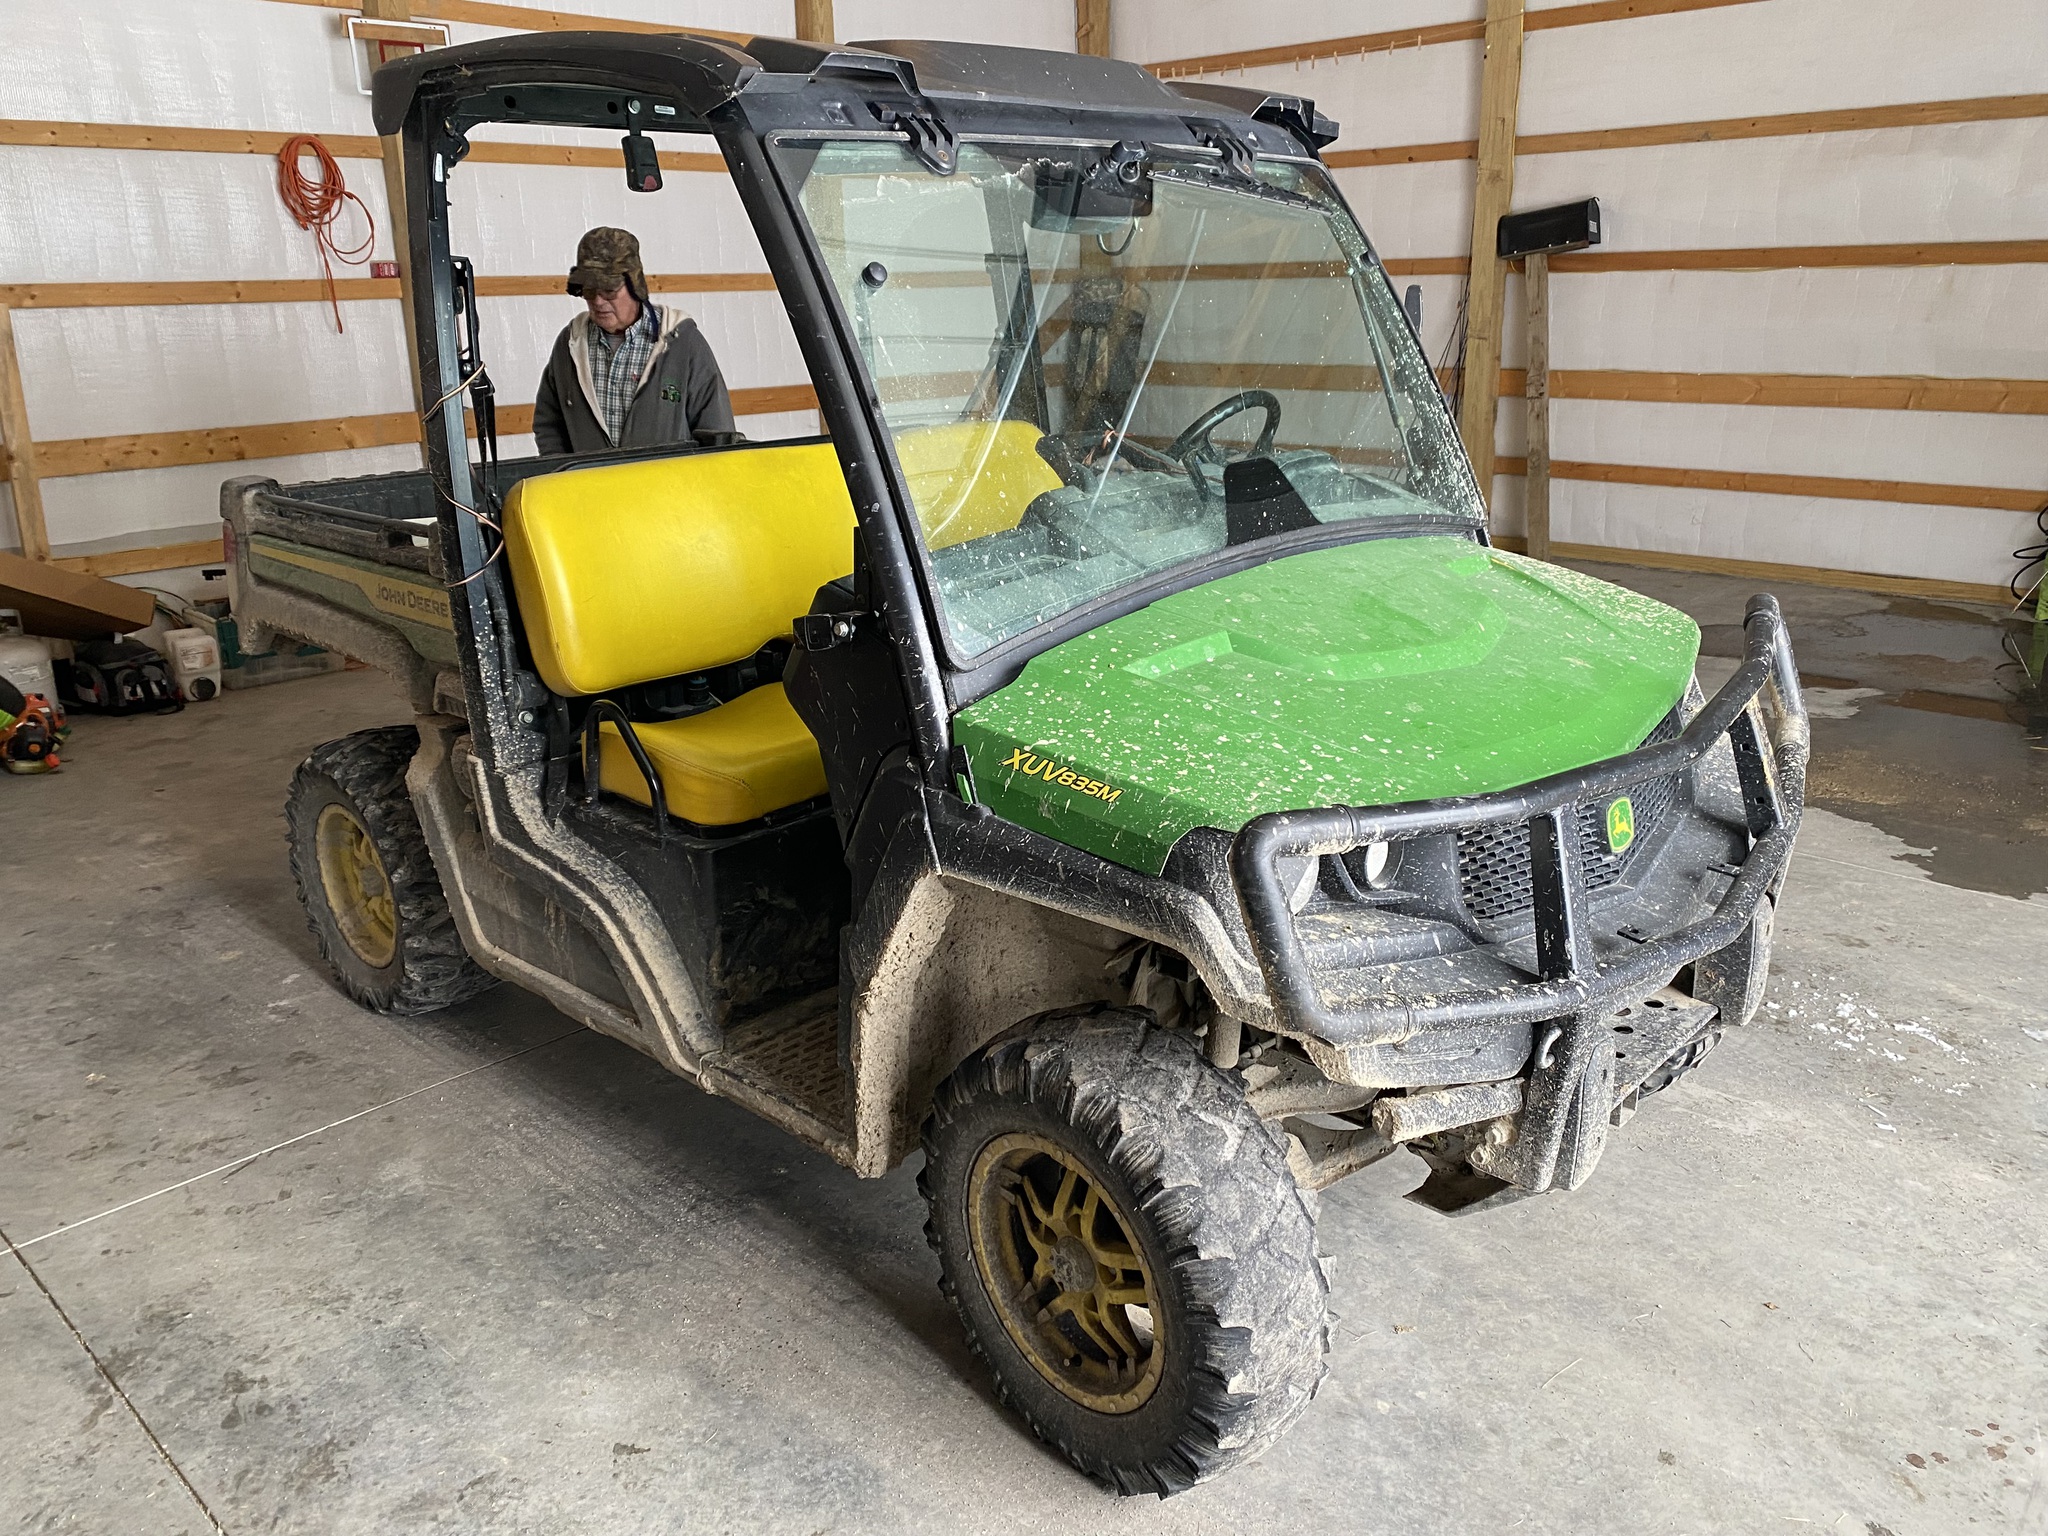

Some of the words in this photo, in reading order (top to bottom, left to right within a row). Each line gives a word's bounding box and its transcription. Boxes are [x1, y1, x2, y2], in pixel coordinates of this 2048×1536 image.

[376, 583, 405, 606] JOHN
[407, 590, 449, 618] DEERE
[999, 747, 1126, 803] XUV835M
